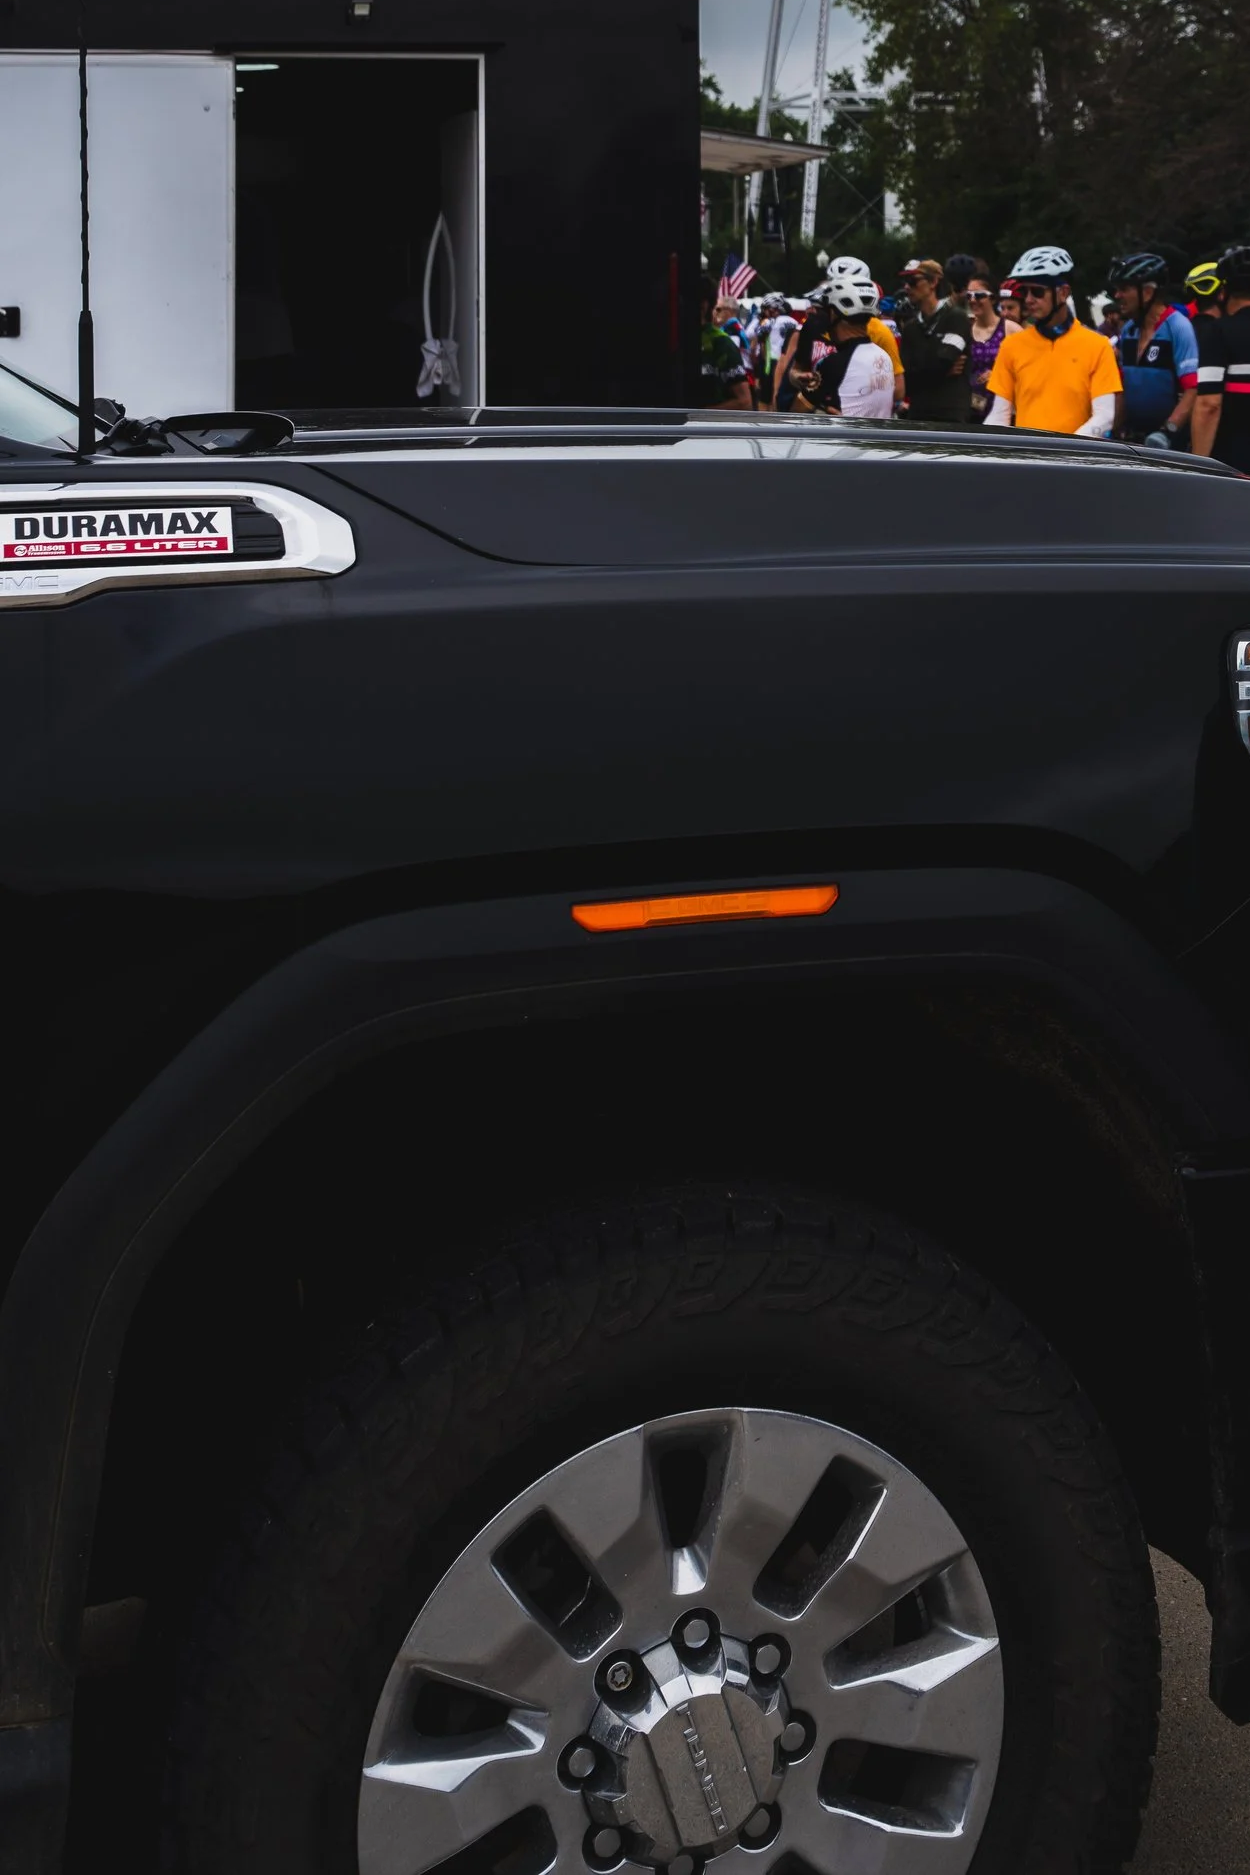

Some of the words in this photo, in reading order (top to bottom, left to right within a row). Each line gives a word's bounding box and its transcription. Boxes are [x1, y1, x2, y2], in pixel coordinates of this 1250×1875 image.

[14, 511, 219, 540] DURAMAX
[28, 544, 66, 552] Allison
[80, 542, 127, 553] 6.6
[134, 540, 218, 551] LITER
[0, 575, 60, 590] MC
[677, 895, 740, 914] GMC
[676, 1702, 729, 1837] DENALI
